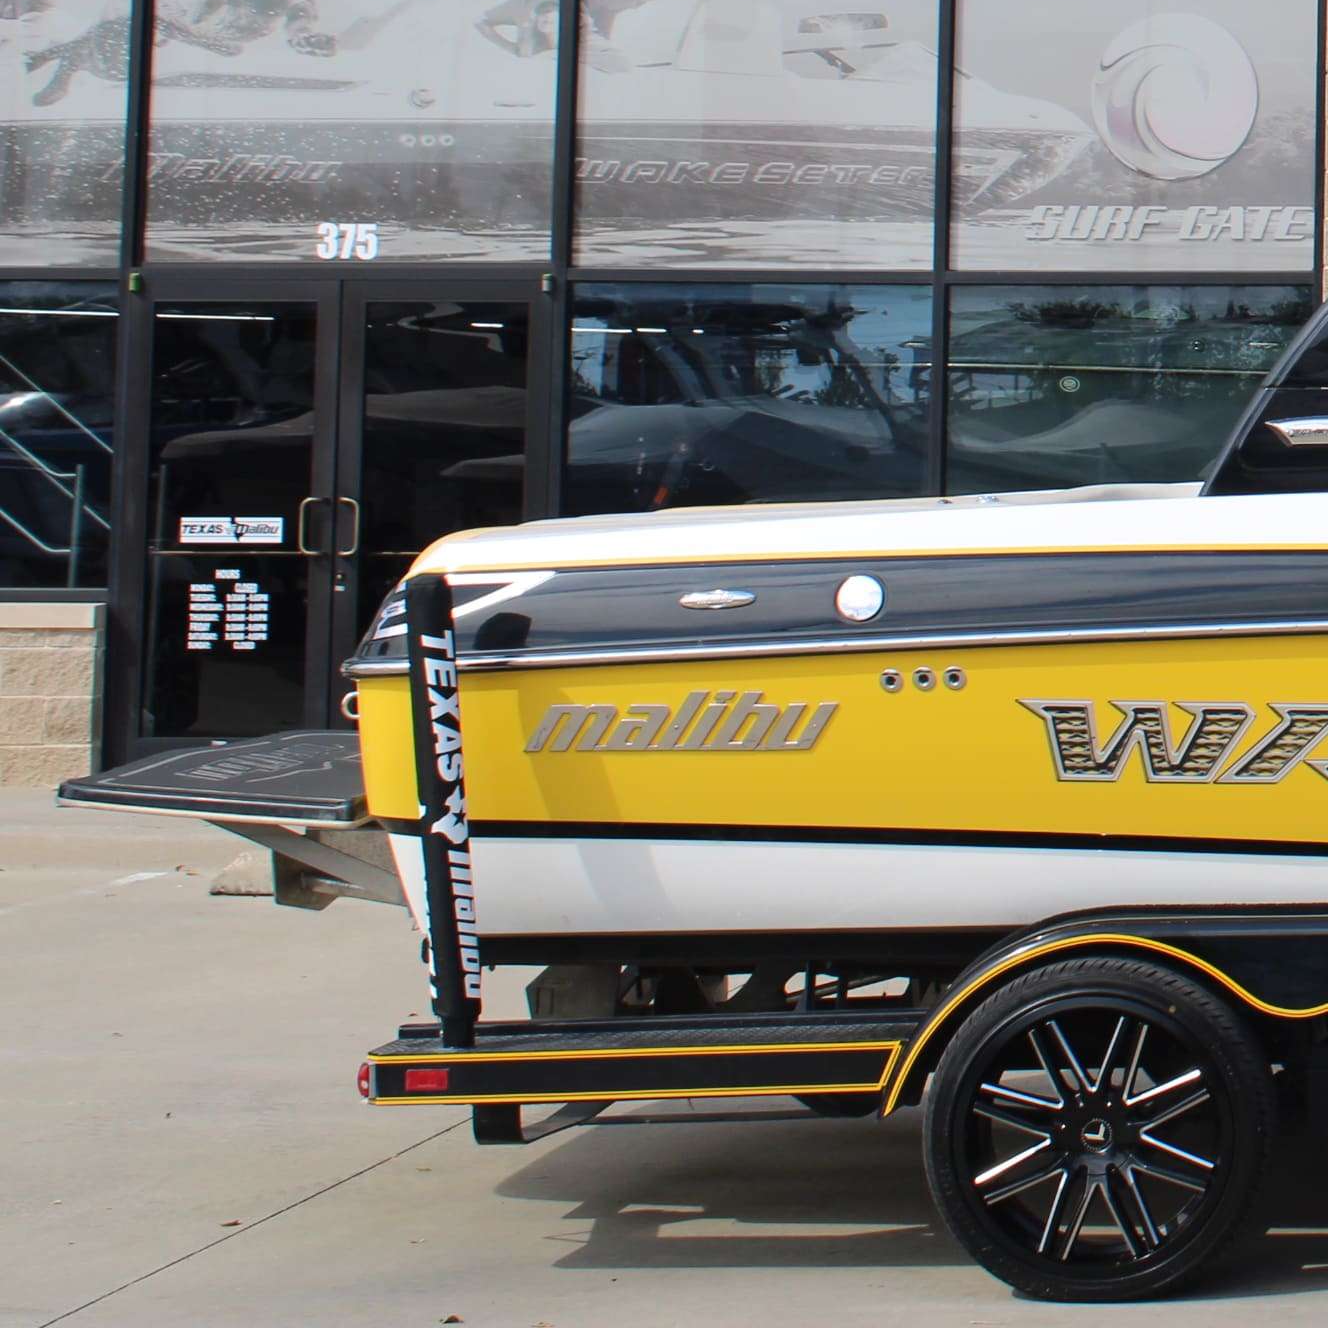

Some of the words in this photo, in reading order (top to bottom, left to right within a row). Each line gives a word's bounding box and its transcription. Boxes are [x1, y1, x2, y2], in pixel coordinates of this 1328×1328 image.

[316, 222, 379, 260] 375
[1024, 205, 1167, 241] SURF
[1178, 205, 1314, 241] GATE
[182, 524, 224, 534] TEXAS
[420, 629, 464, 782] TEXAS
